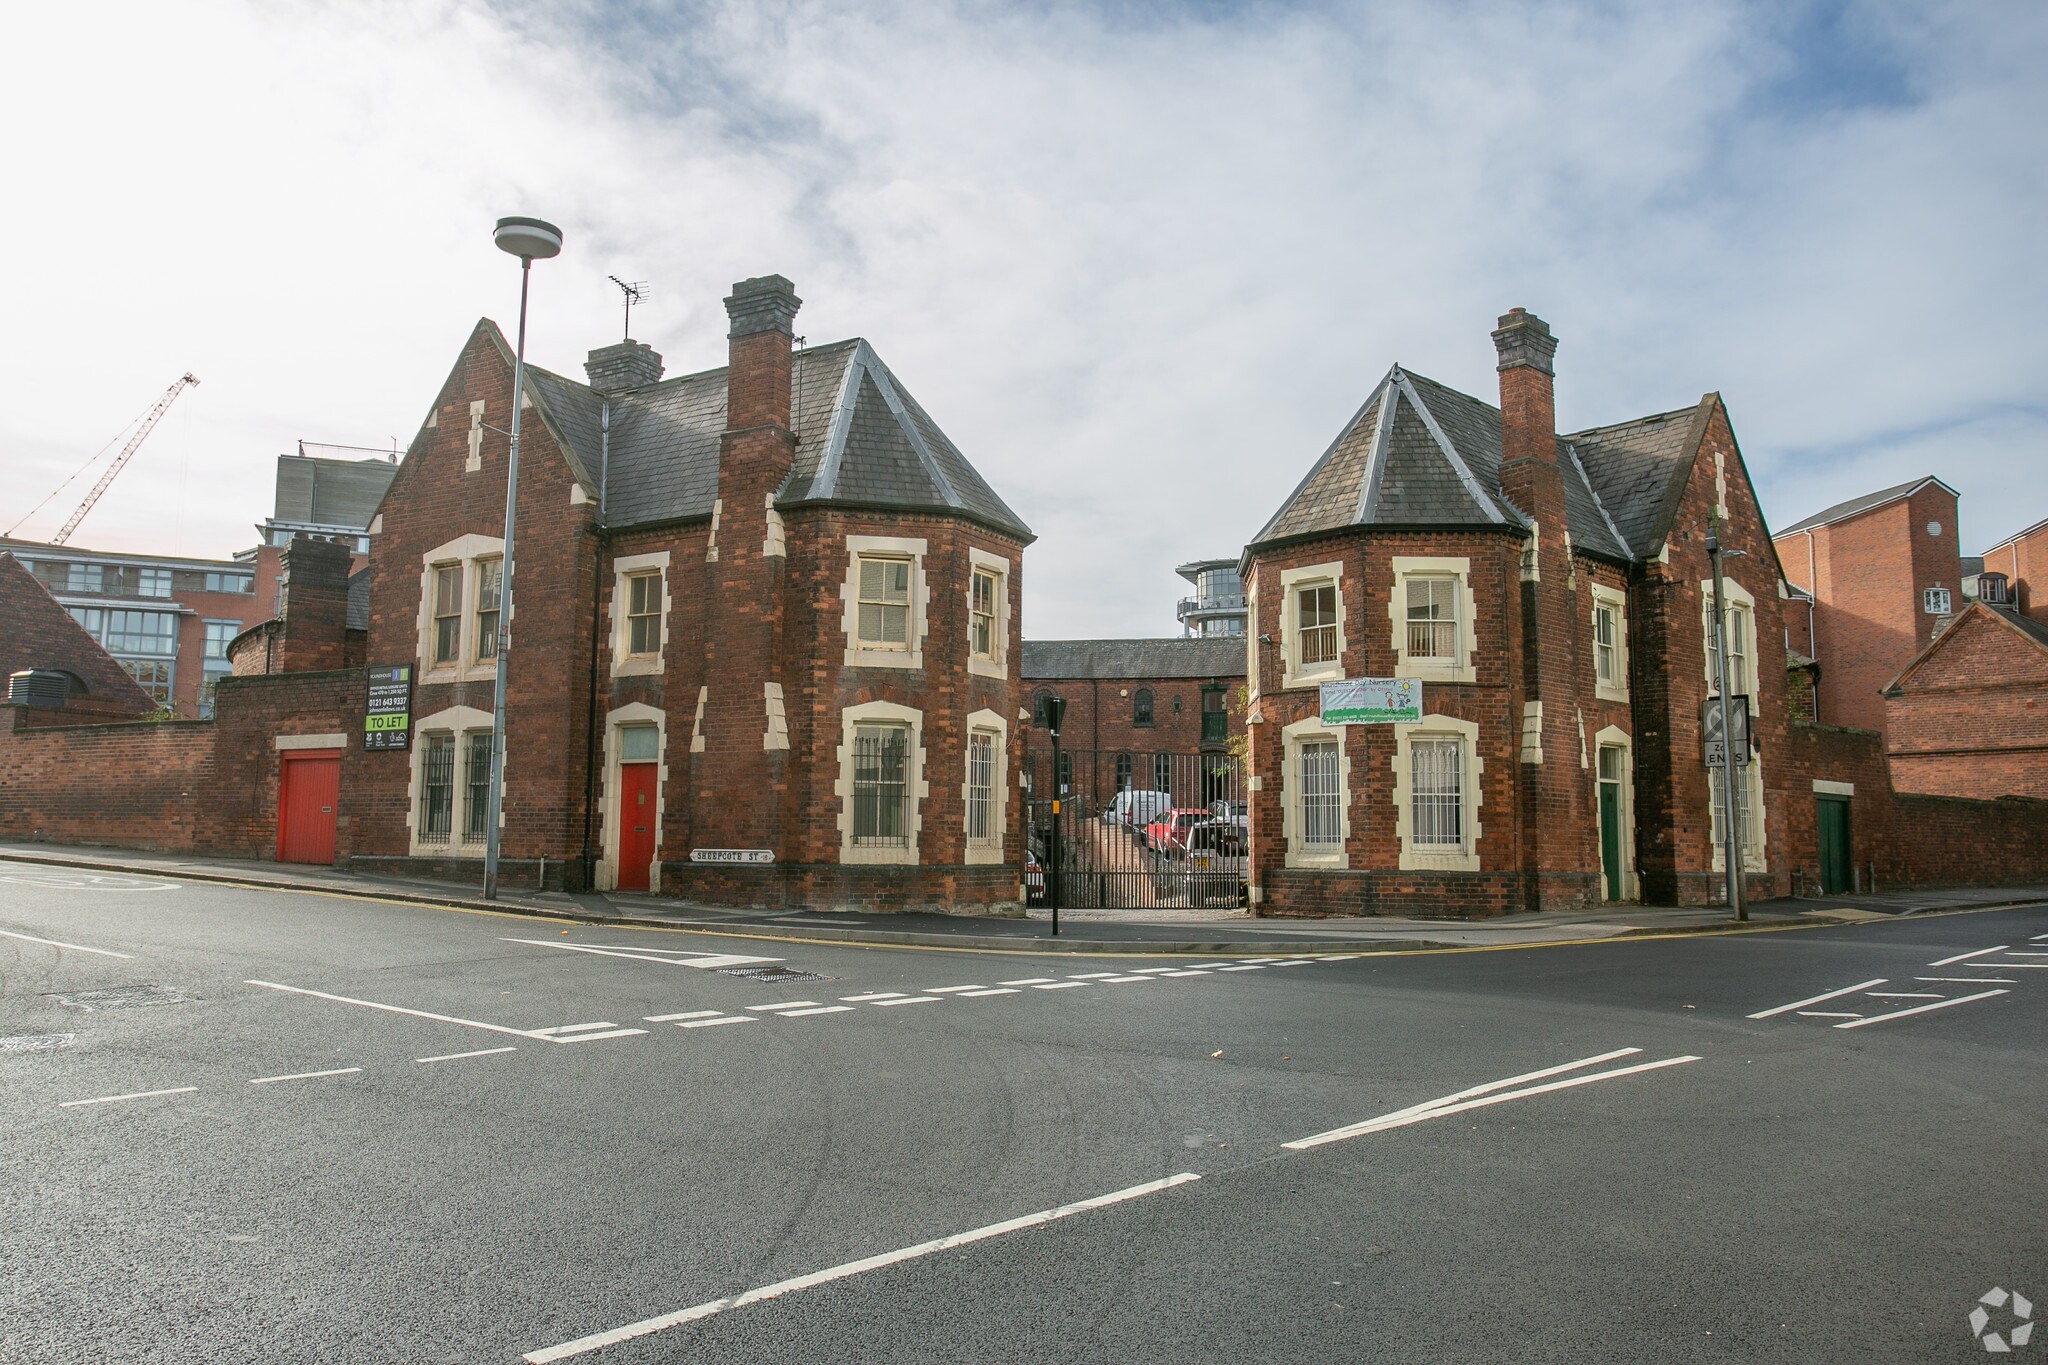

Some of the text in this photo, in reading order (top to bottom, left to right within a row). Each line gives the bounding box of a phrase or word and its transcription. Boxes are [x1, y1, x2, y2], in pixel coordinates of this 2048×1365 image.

[393, 697, 407, 705] 9337
[372, 716, 403, 728] TO LET
[1709, 753, 1743, 763] ENS
[697, 852, 742, 860] SHEEPCOTE
